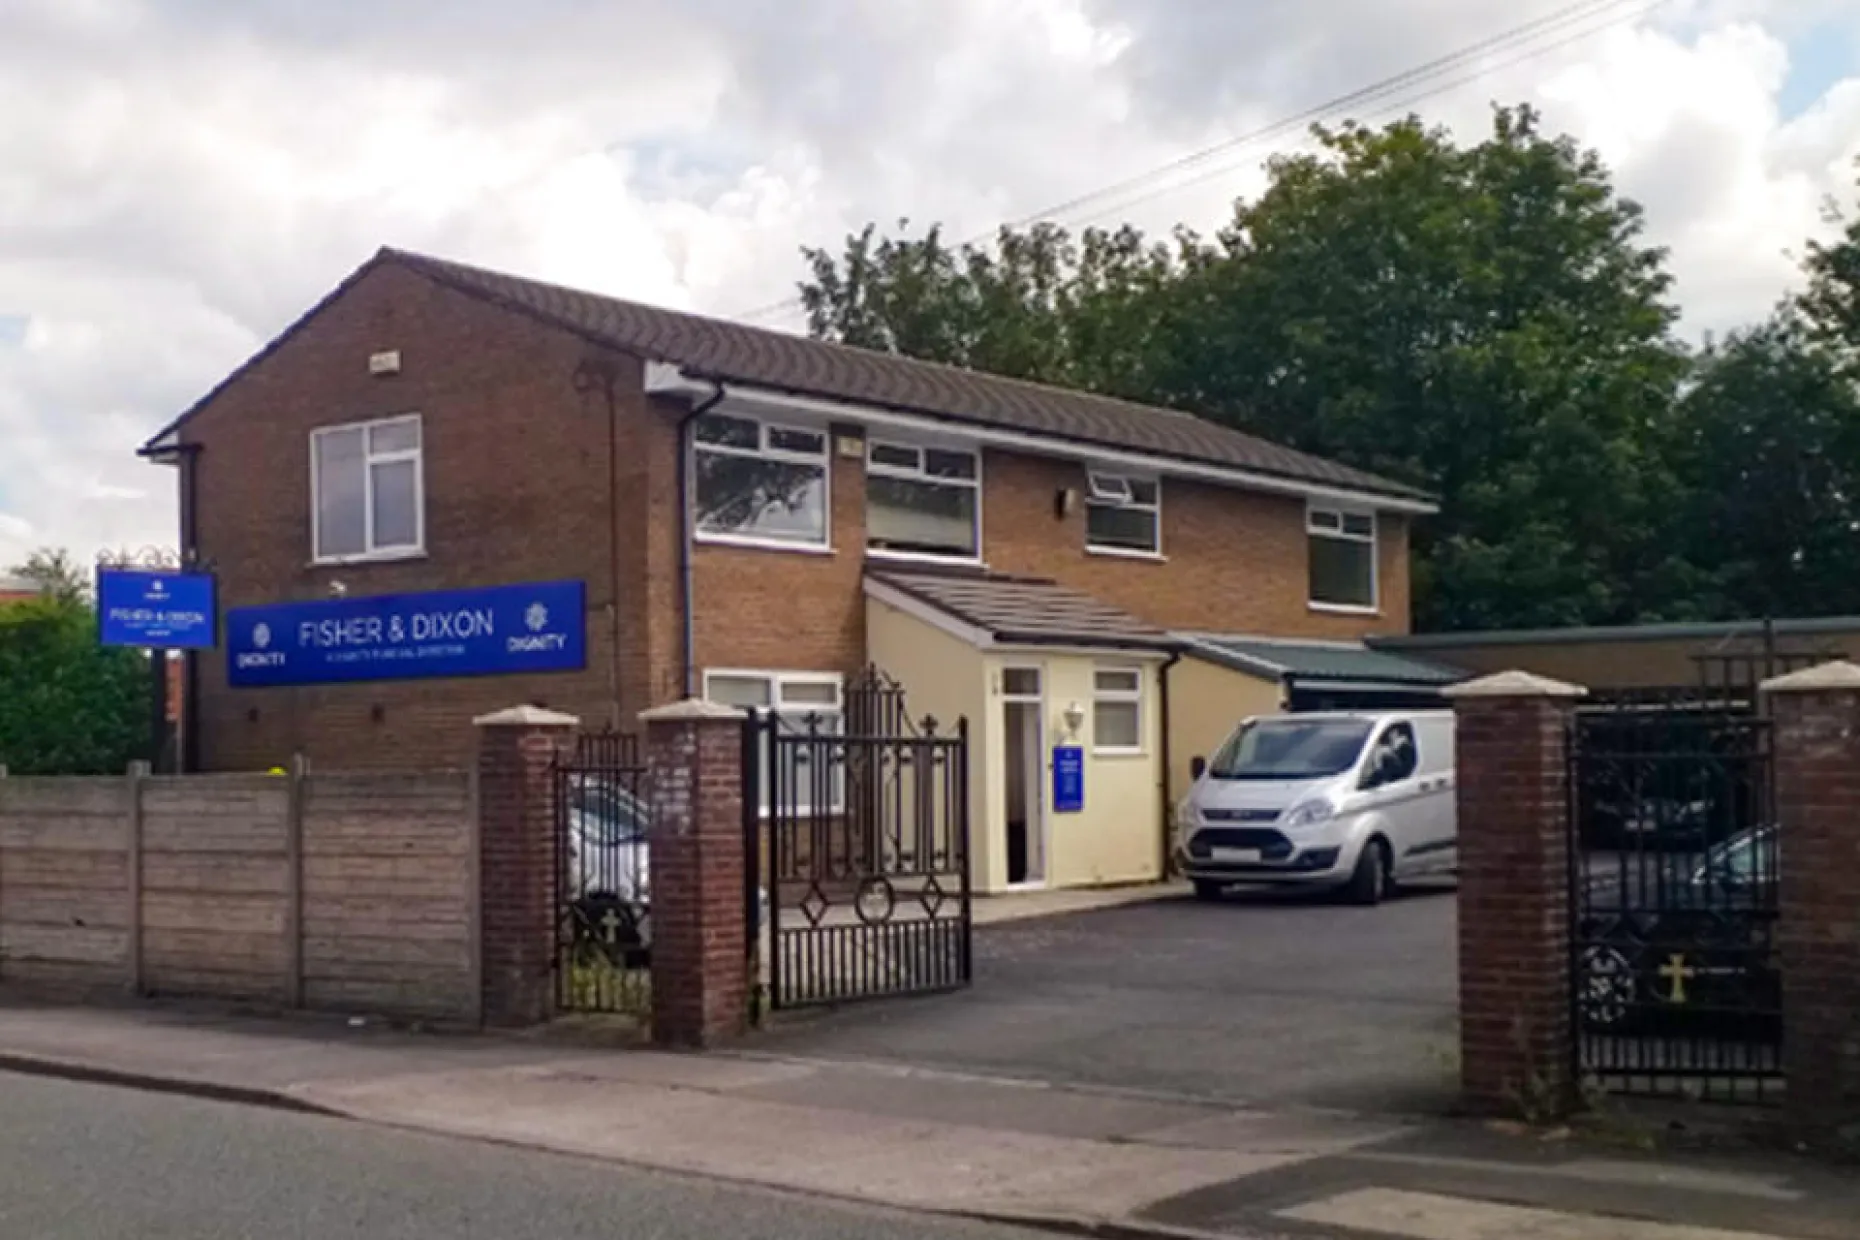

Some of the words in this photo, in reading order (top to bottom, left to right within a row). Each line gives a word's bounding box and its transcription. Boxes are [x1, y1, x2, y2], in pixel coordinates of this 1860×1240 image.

[299, 617, 382, 647] FISHER
[388, 613, 404, 642] &
[411, 608, 494, 640] DIXON
